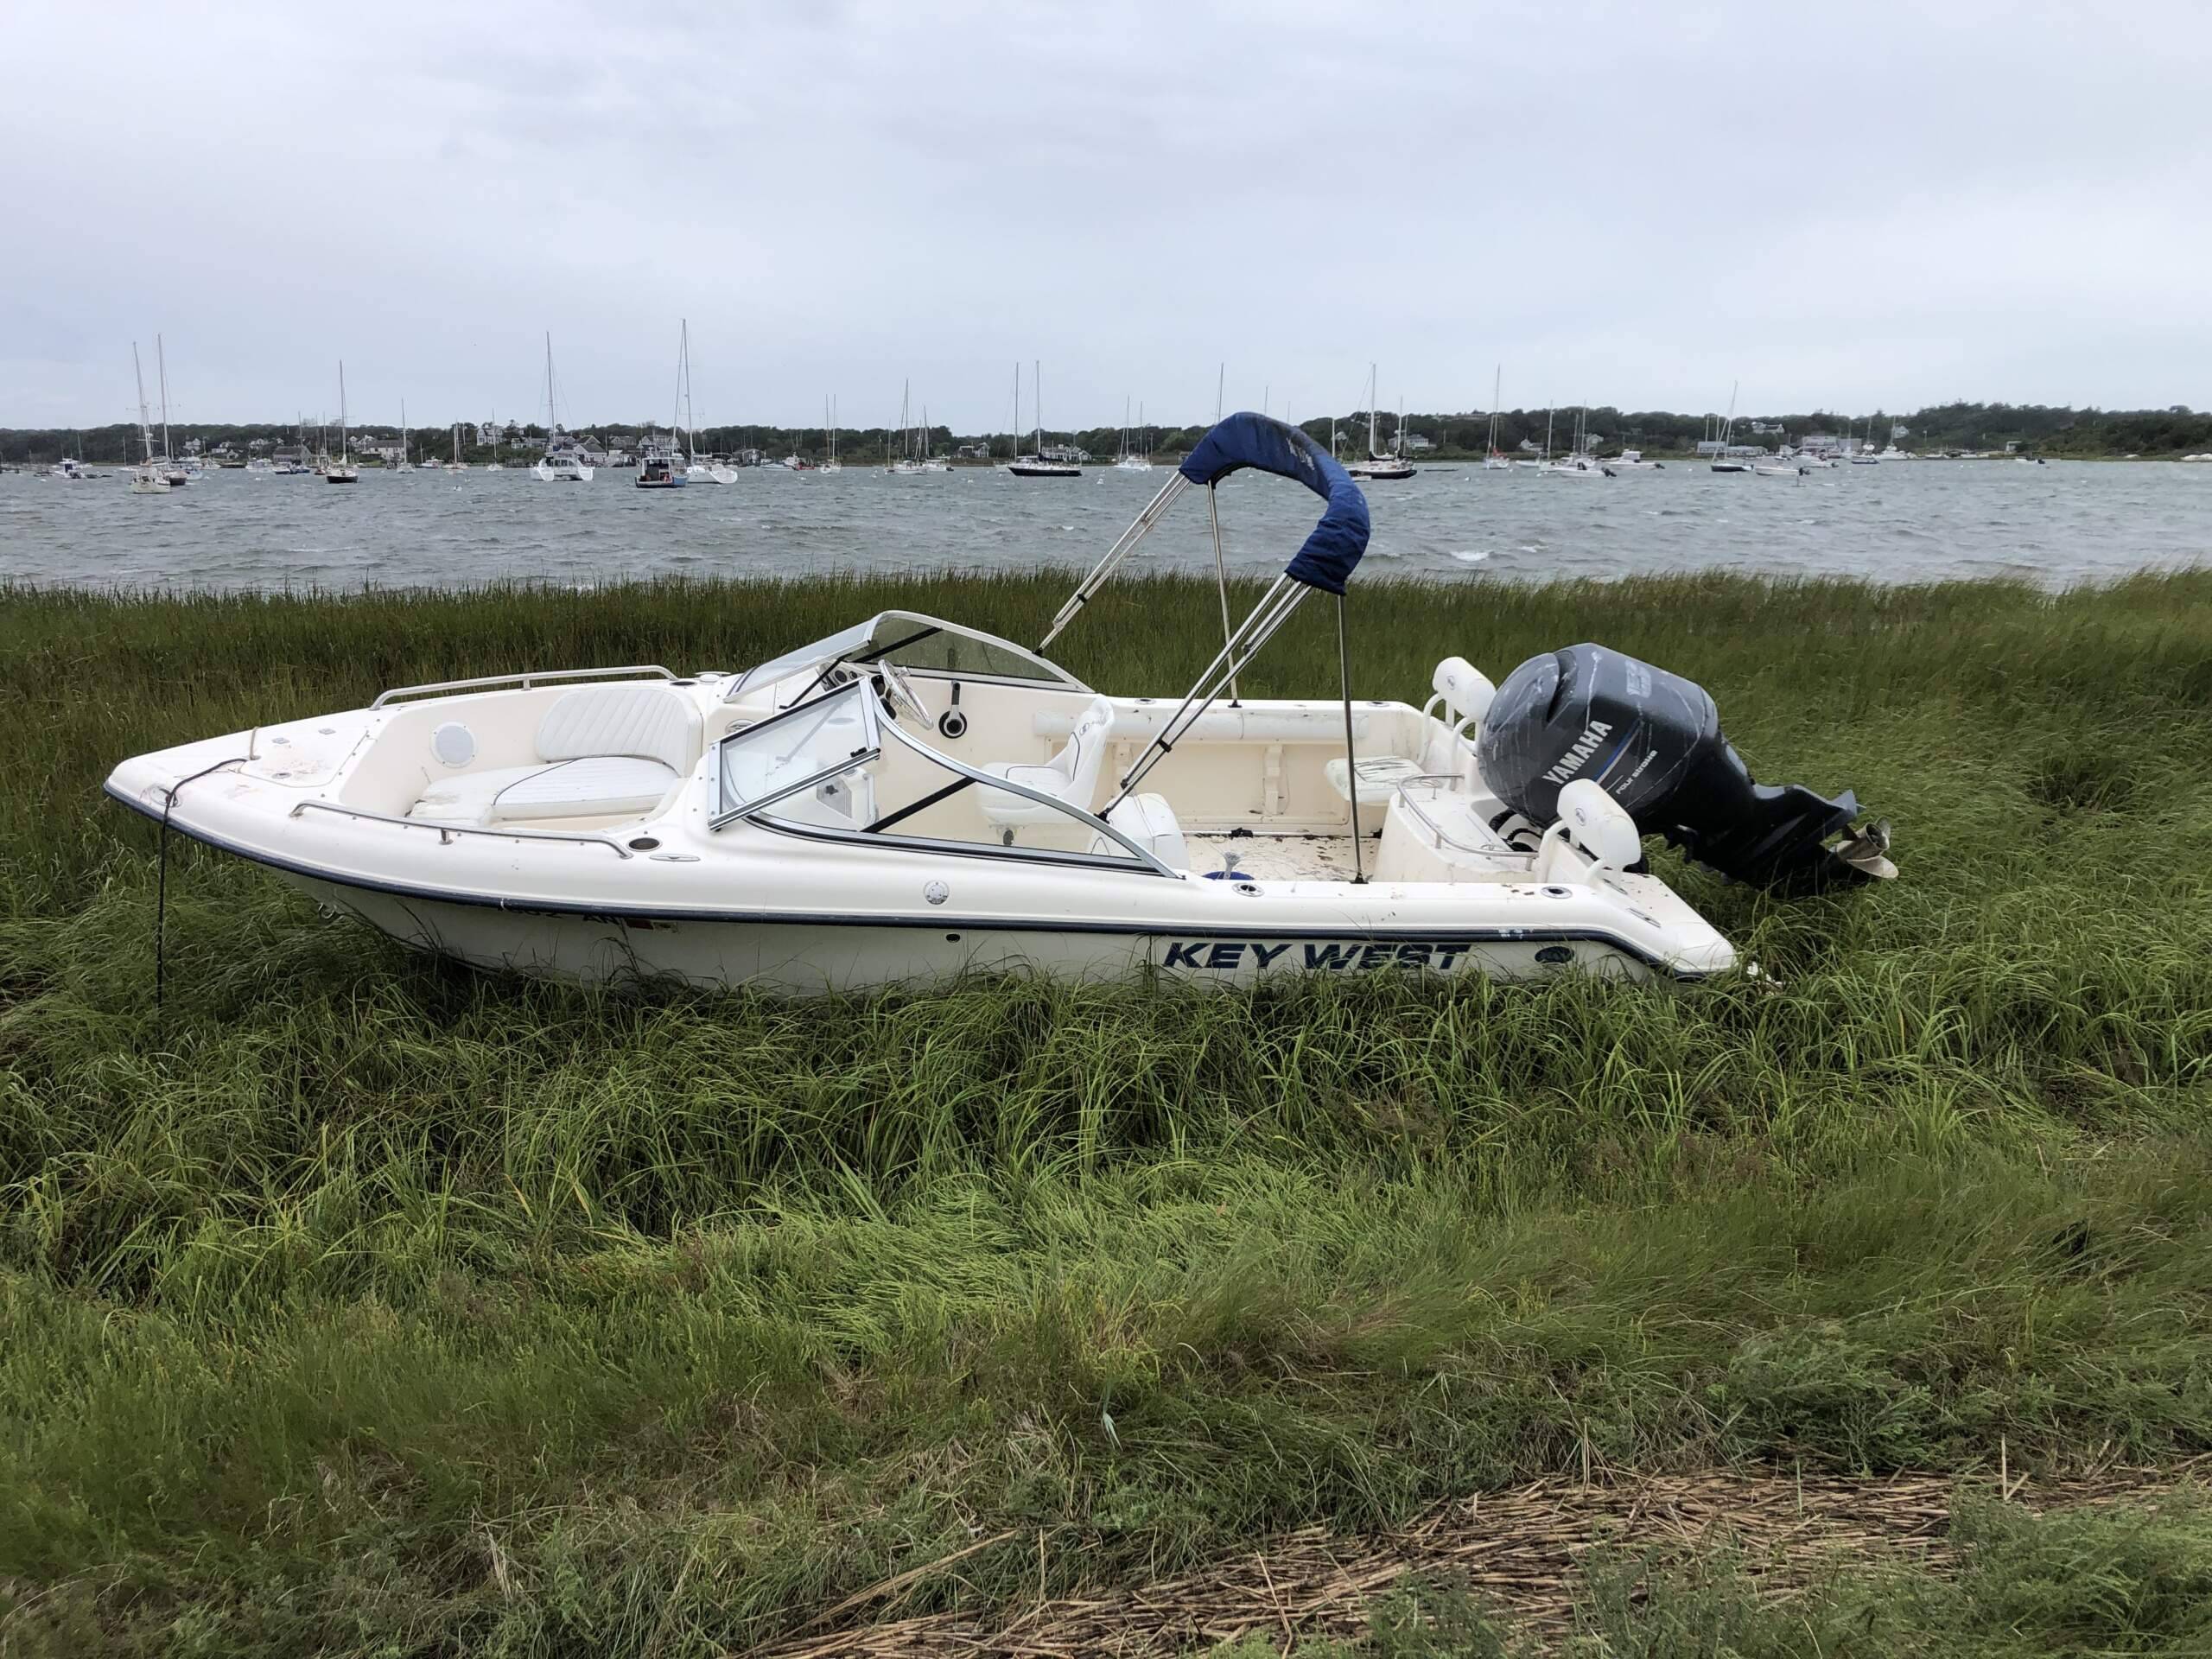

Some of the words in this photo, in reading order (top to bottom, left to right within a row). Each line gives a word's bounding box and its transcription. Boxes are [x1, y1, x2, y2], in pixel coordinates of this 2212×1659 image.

[1541, 720, 1613, 785] YAMAHA
[1161, 941, 1294, 969] KEY
[1303, 943, 1472, 970] WEST
